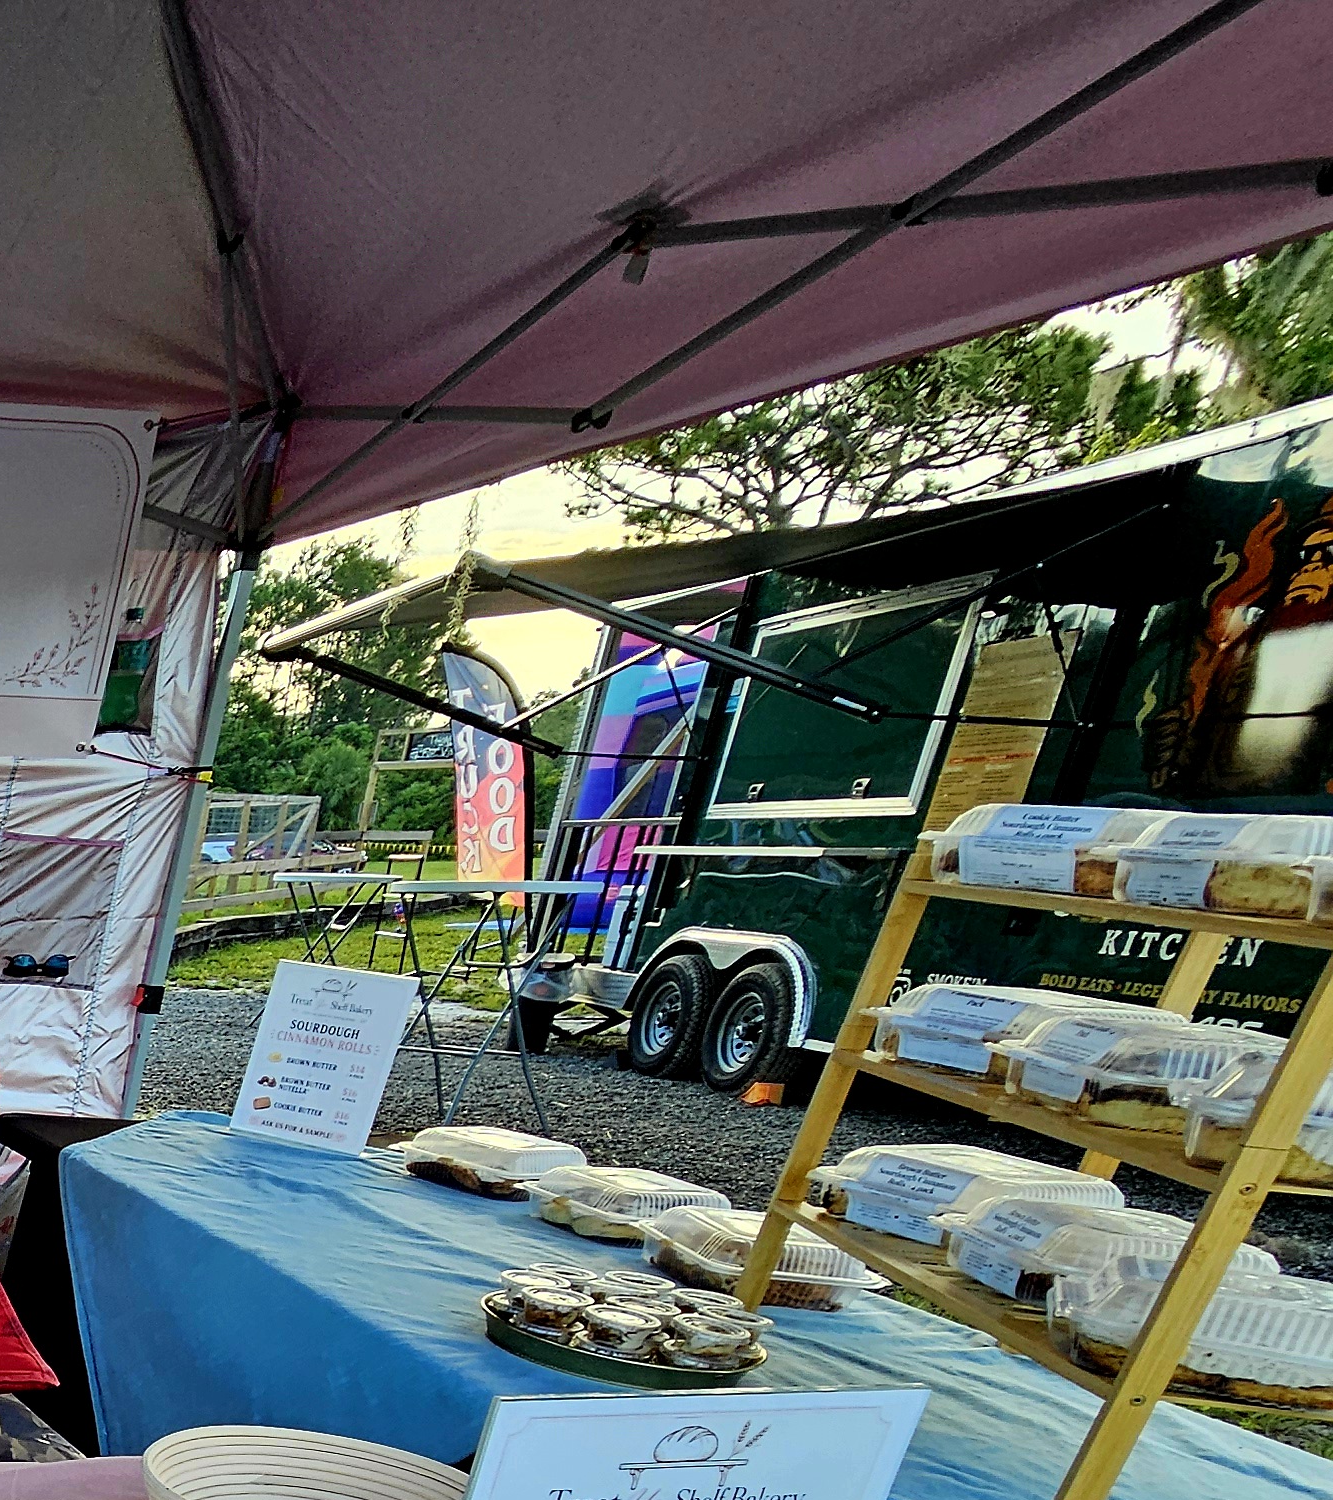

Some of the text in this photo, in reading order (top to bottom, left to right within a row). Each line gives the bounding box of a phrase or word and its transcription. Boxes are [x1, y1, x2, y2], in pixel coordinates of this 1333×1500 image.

[1098, 929, 1264, 968] KITCEN
[1038, 973, 1303, 1014] BOLD EATS LEGERY FLAVORS
[290, 1019, 361, 1040] SOURDOUGH
[277, 1030, 373, 1055] CINNAMON ROLLS
[286, 1057, 338, 1071] BROWN BUTTER
[281, 1076, 331, 1091] BROWN BUTTER
[274, 1101, 323, 1117] COOKIE BUTTER
[261, 1120, 273, 1128] ASK
[284, 1124, 297, 1132] FOR
